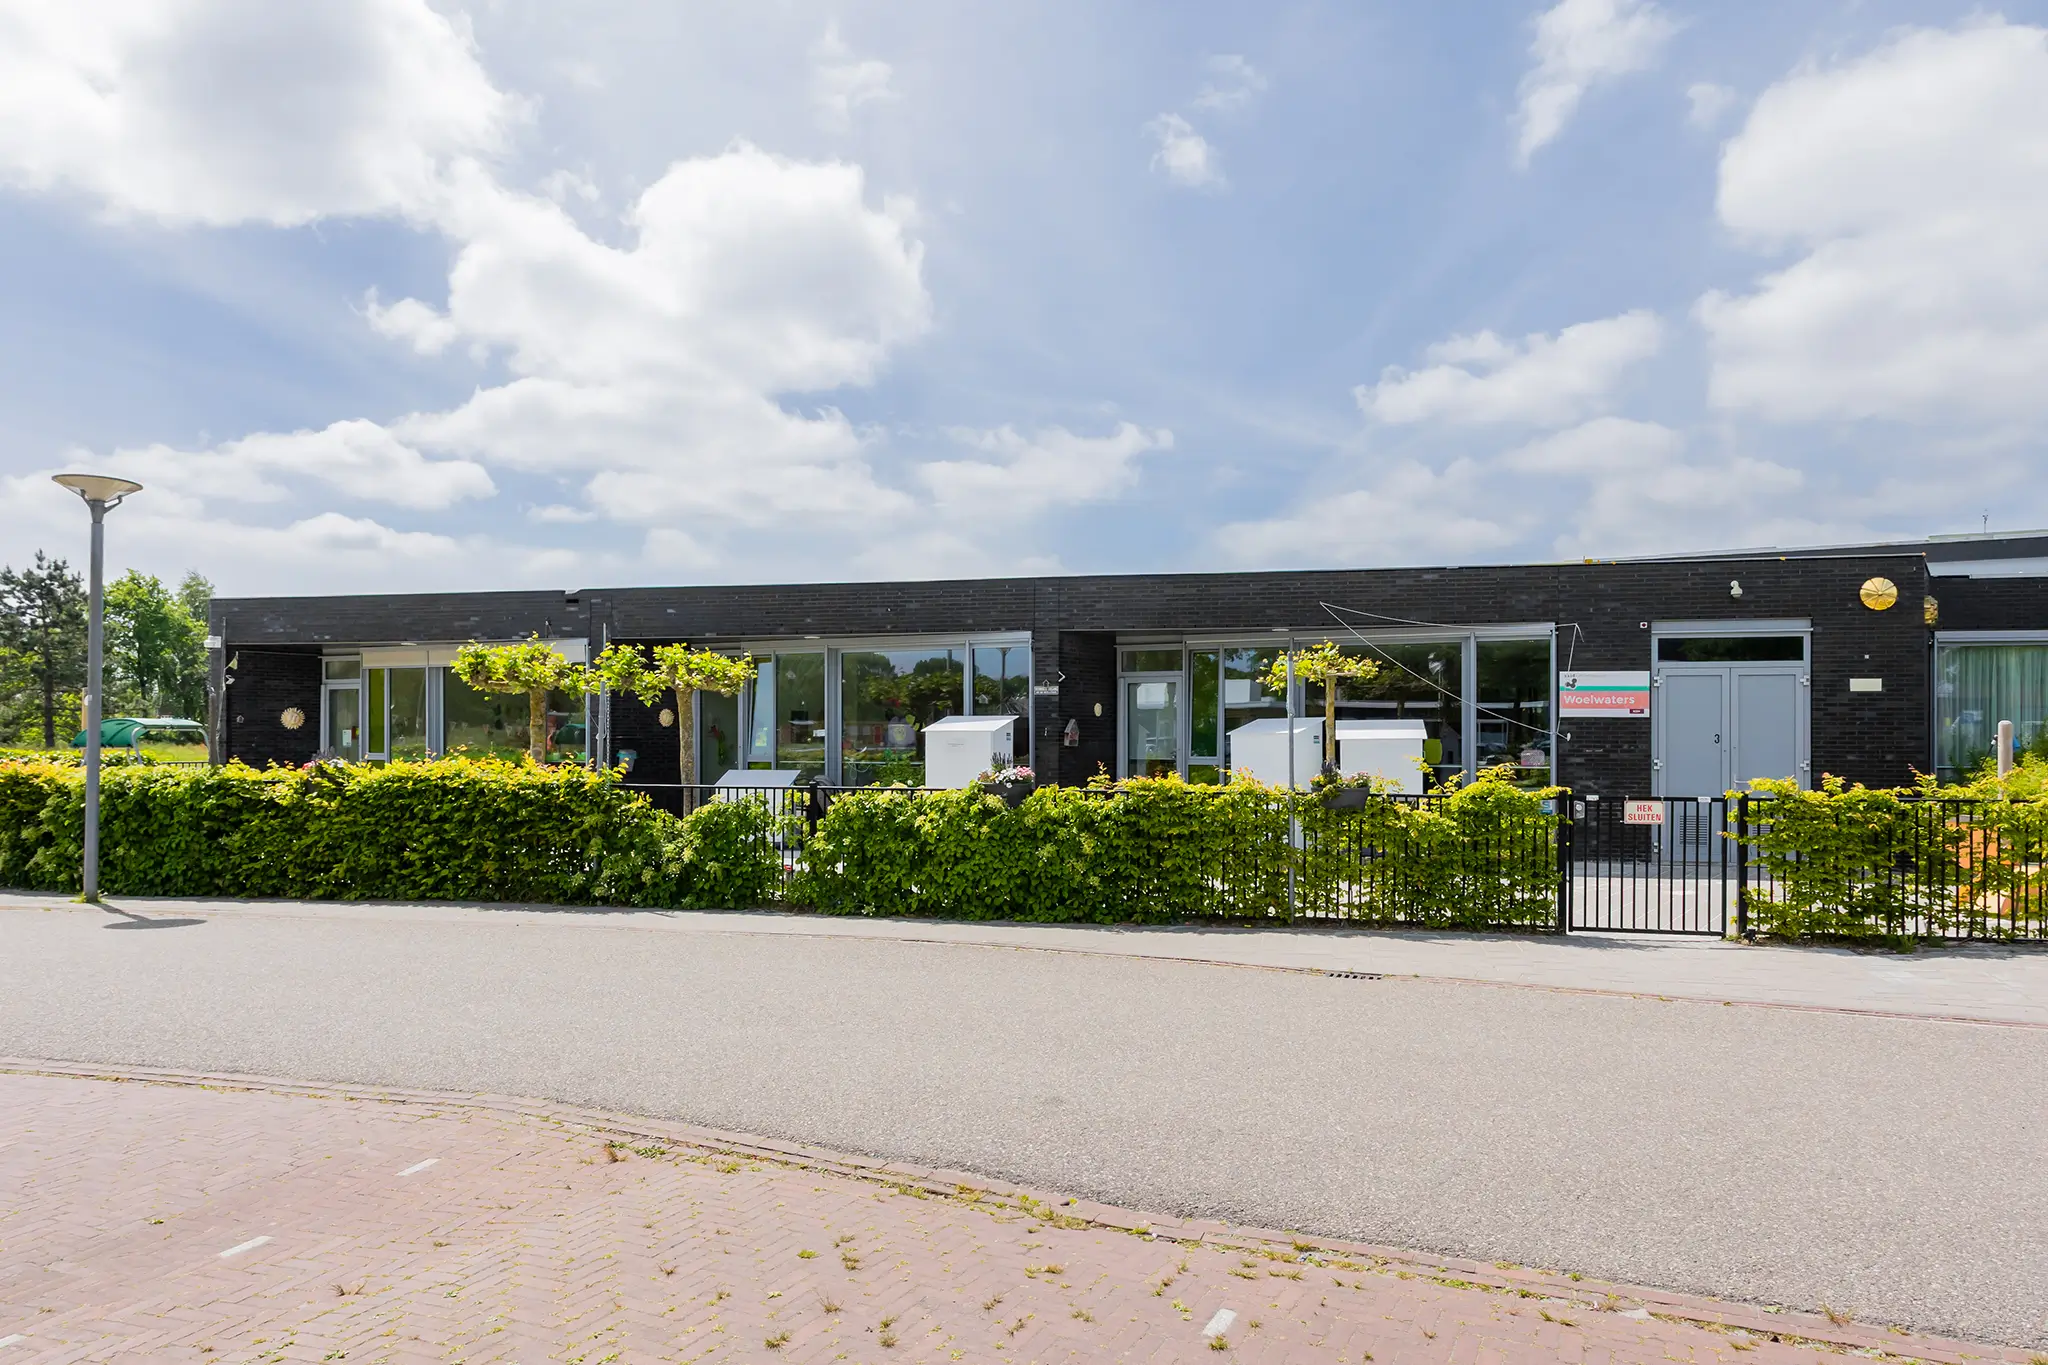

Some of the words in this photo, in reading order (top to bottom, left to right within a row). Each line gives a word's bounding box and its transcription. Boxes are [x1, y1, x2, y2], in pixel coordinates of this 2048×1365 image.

[1563, 695, 1635, 704] Woelwaters
[1714, 733, 1720, 744] 3
[1636, 804, 1653, 812] HEK
[1627, 813, 1662, 821] SLUITEN
